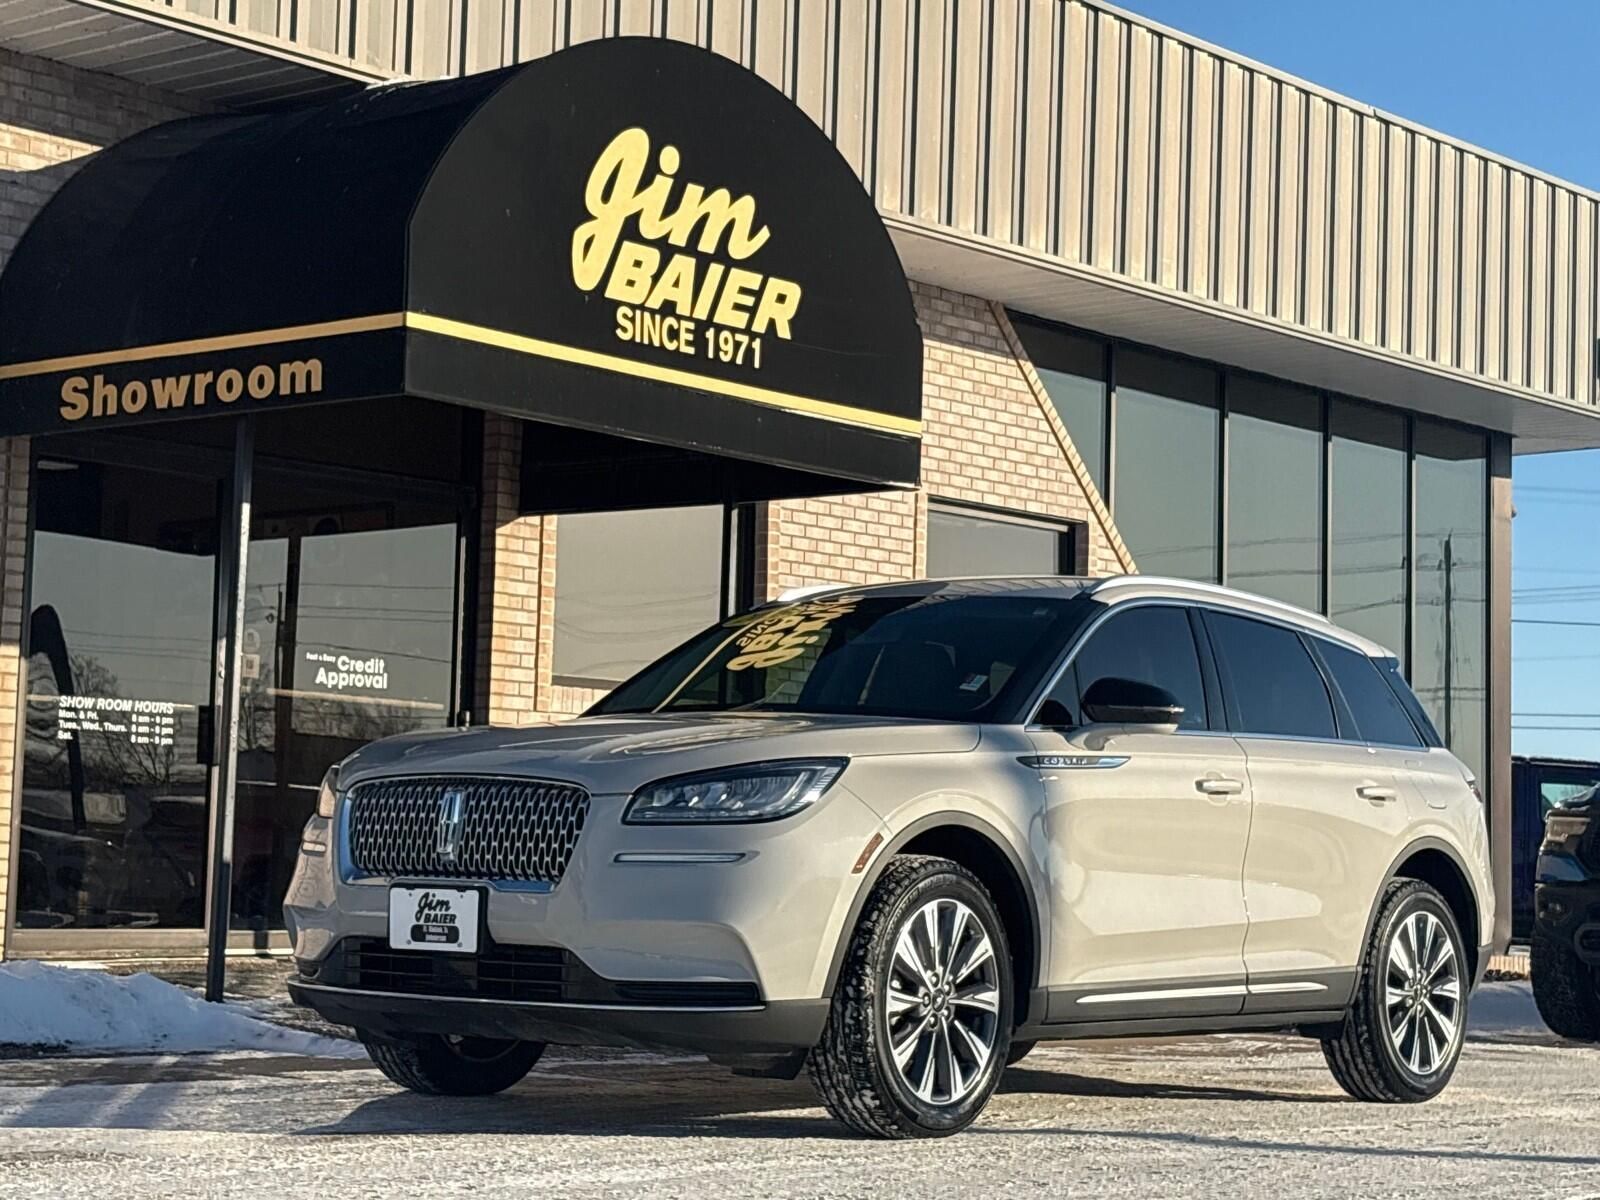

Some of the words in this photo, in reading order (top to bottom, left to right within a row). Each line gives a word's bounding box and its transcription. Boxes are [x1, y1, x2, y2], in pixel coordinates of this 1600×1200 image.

[571, 127, 771, 291] Jim
[604, 240, 802, 340] BAIER
[615, 306, 696, 355] SINCE
[705, 327, 762, 369] 1971
[59, 358, 322, 421] Showroom
[337, 655, 385, 674] Credit
[315, 667, 388, 690] Approval
[58, 708, 78, 719] Mon.
[59, 695, 95, 709] SHOW
[96, 697, 133, 711] ROOM
[134, 700, 174, 714] HOURS
[415, 892, 452, 923] Jim
[423, 913, 457, 925] BAIER
